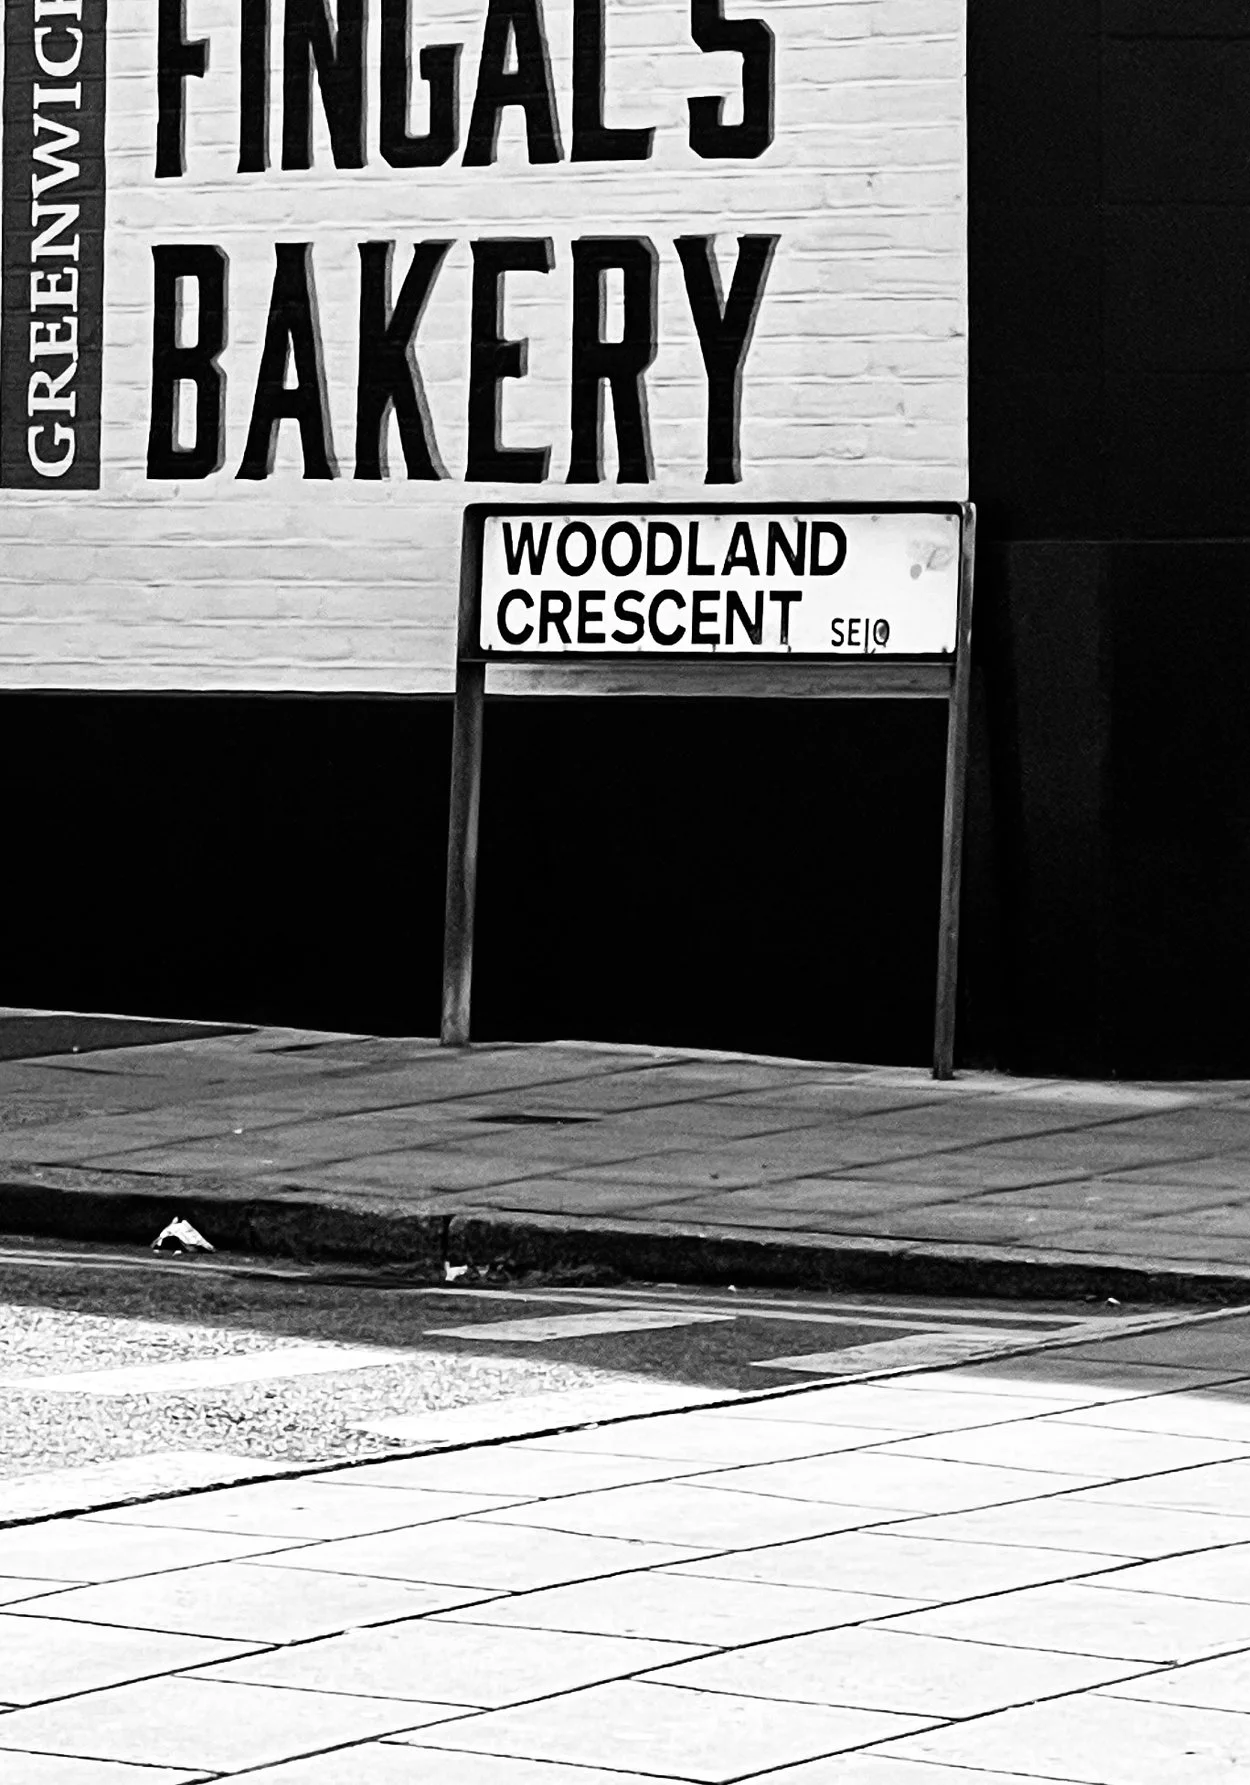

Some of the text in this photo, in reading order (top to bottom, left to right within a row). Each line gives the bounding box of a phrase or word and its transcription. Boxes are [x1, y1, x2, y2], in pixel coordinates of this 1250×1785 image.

[147, 234, 782, 484] BAKERY
[502, 520, 847, 577] WOODLAND
[497, 588, 803, 647] CRESCENT
